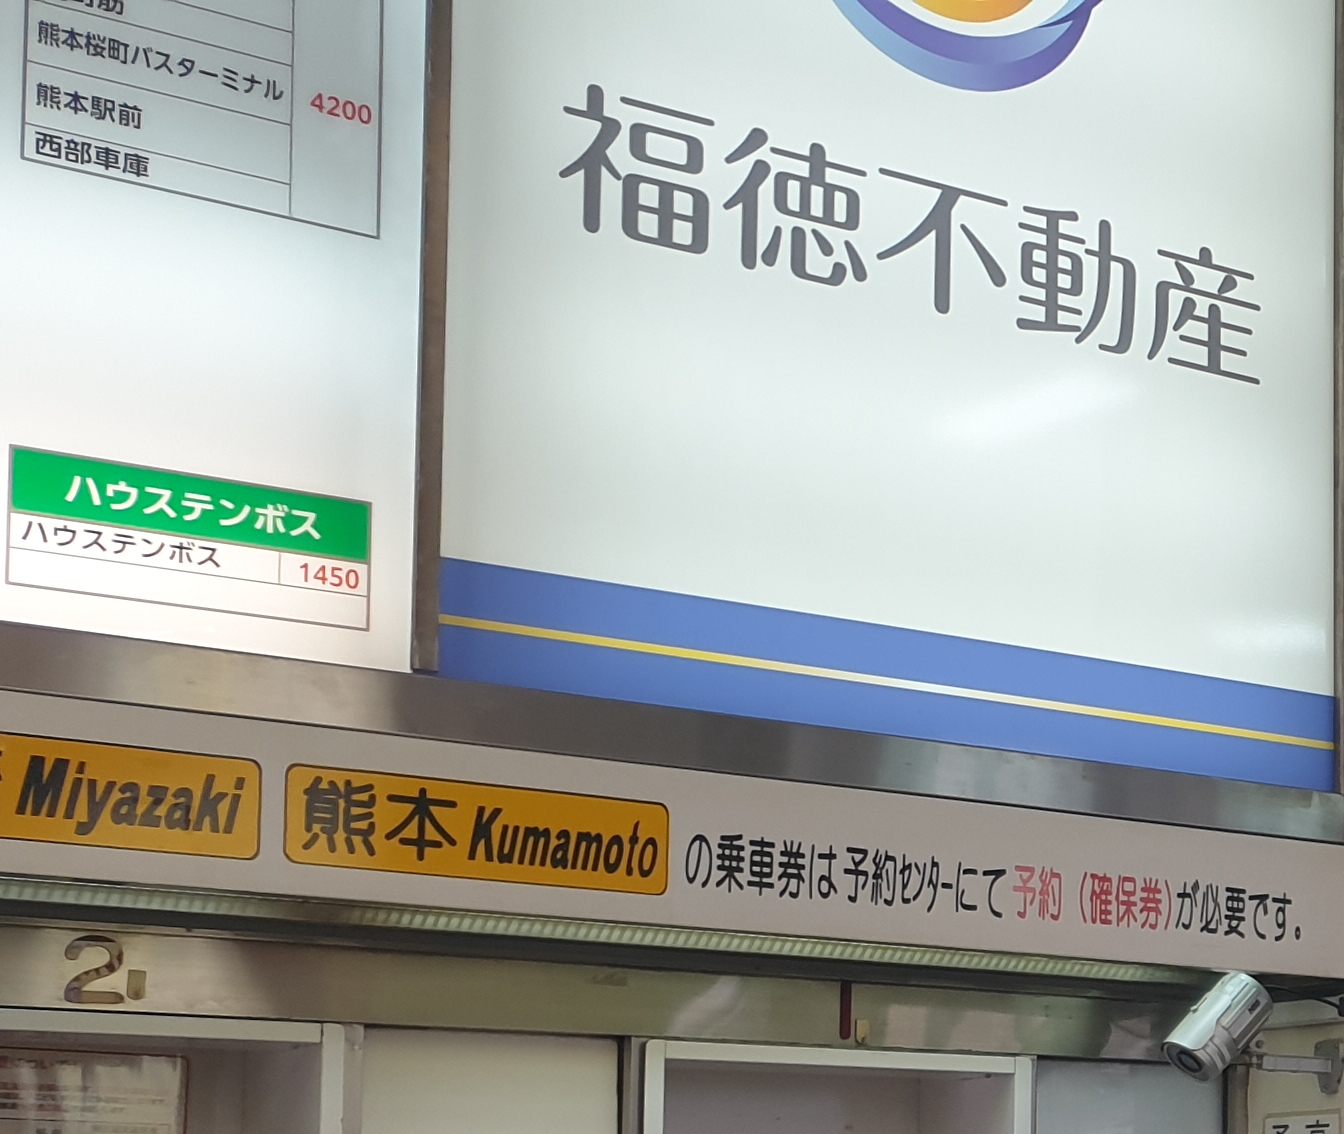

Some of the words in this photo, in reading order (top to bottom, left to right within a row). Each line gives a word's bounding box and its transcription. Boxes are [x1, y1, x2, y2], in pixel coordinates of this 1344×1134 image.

[37, 20, 285, 102] 熊本桜町バスターミナル
[35, 82, 143, 130] 熊本駅前
[309, 92, 372, 126] 4200
[34, 131, 150, 178] 西部車庫
[559, 84, 1261, 385] 福徳不動産
[65, 474, 322, 541] ハウステンボス
[20, 519, 222, 568] ハウステンボス
[298, 562, 360, 590] 1450
[15, 754, 245, 836] Miyazaki
[302, 775, 457, 861] 熊本
[467, 806, 658, 878] Kumamoto
[64, 935, 125, 1004] 2
